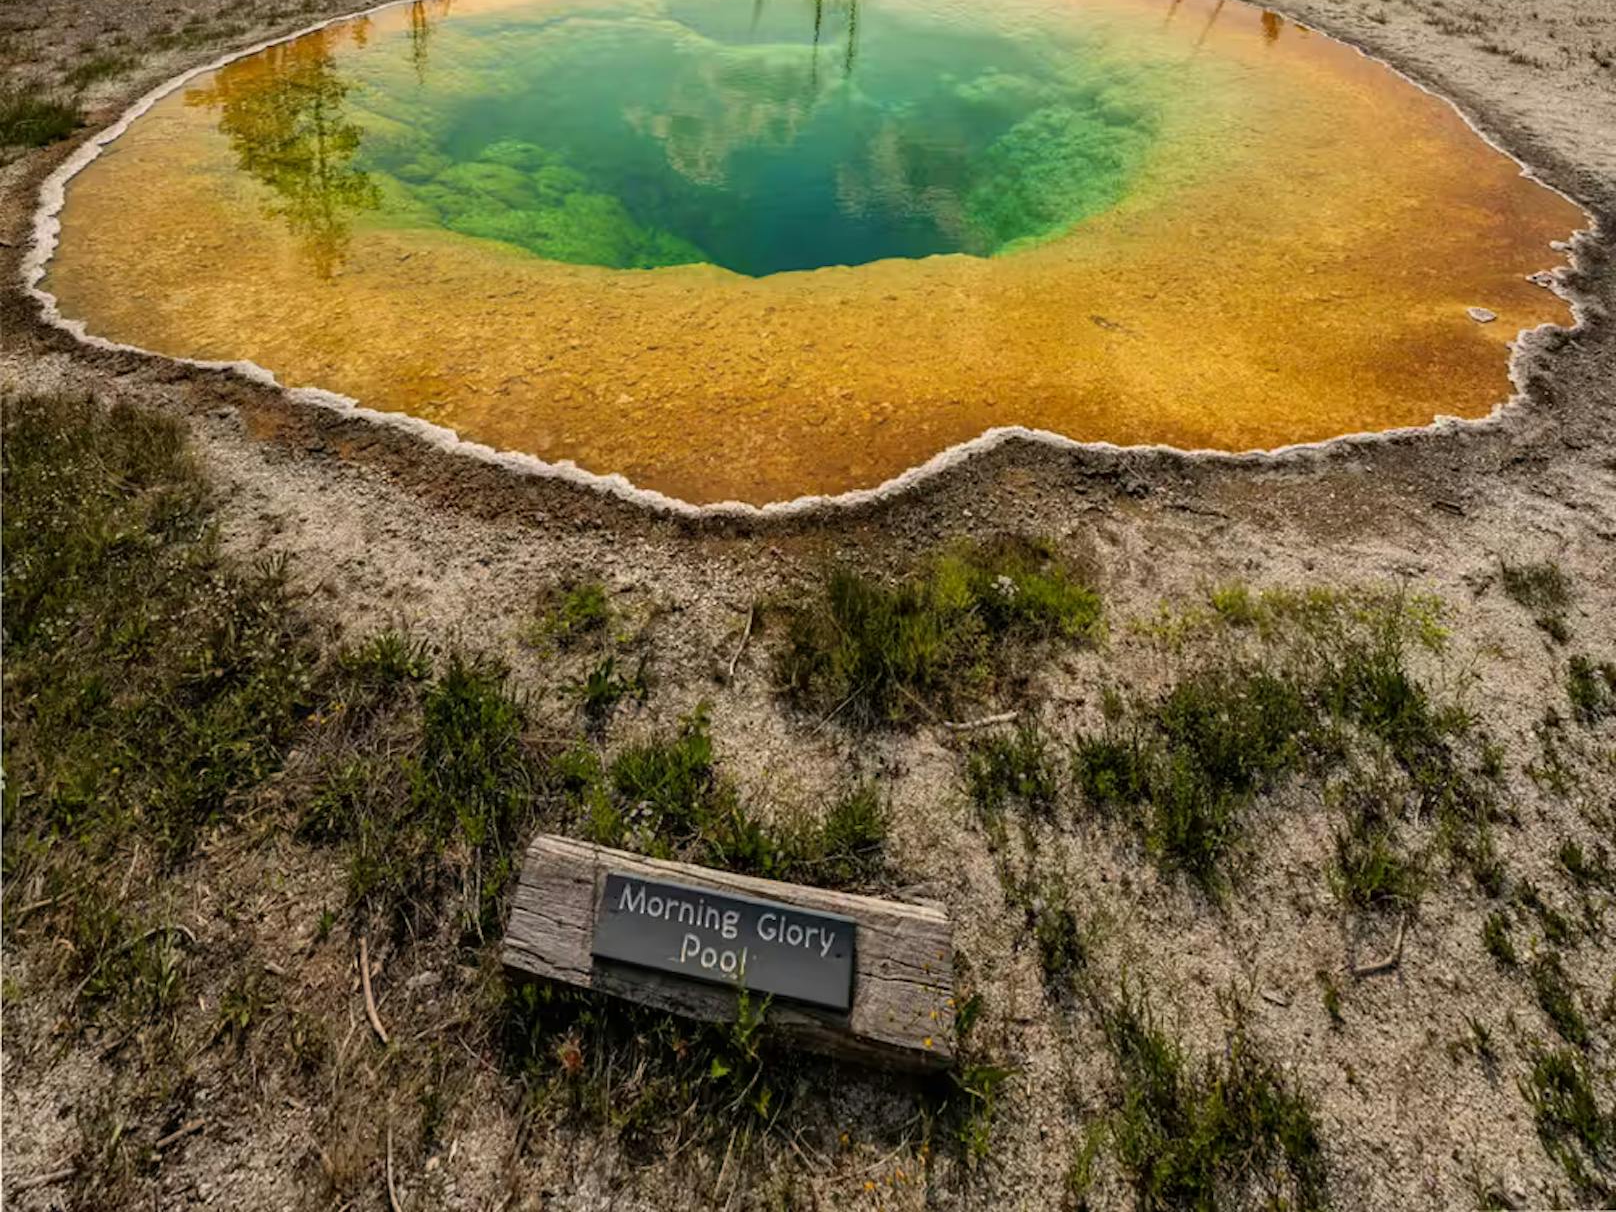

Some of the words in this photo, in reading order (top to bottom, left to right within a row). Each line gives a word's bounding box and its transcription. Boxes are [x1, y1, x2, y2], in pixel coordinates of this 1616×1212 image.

[618, 883, 741, 939] Morning
[756, 913, 836, 957] Glory
[680, 933, 748, 975] Pool
